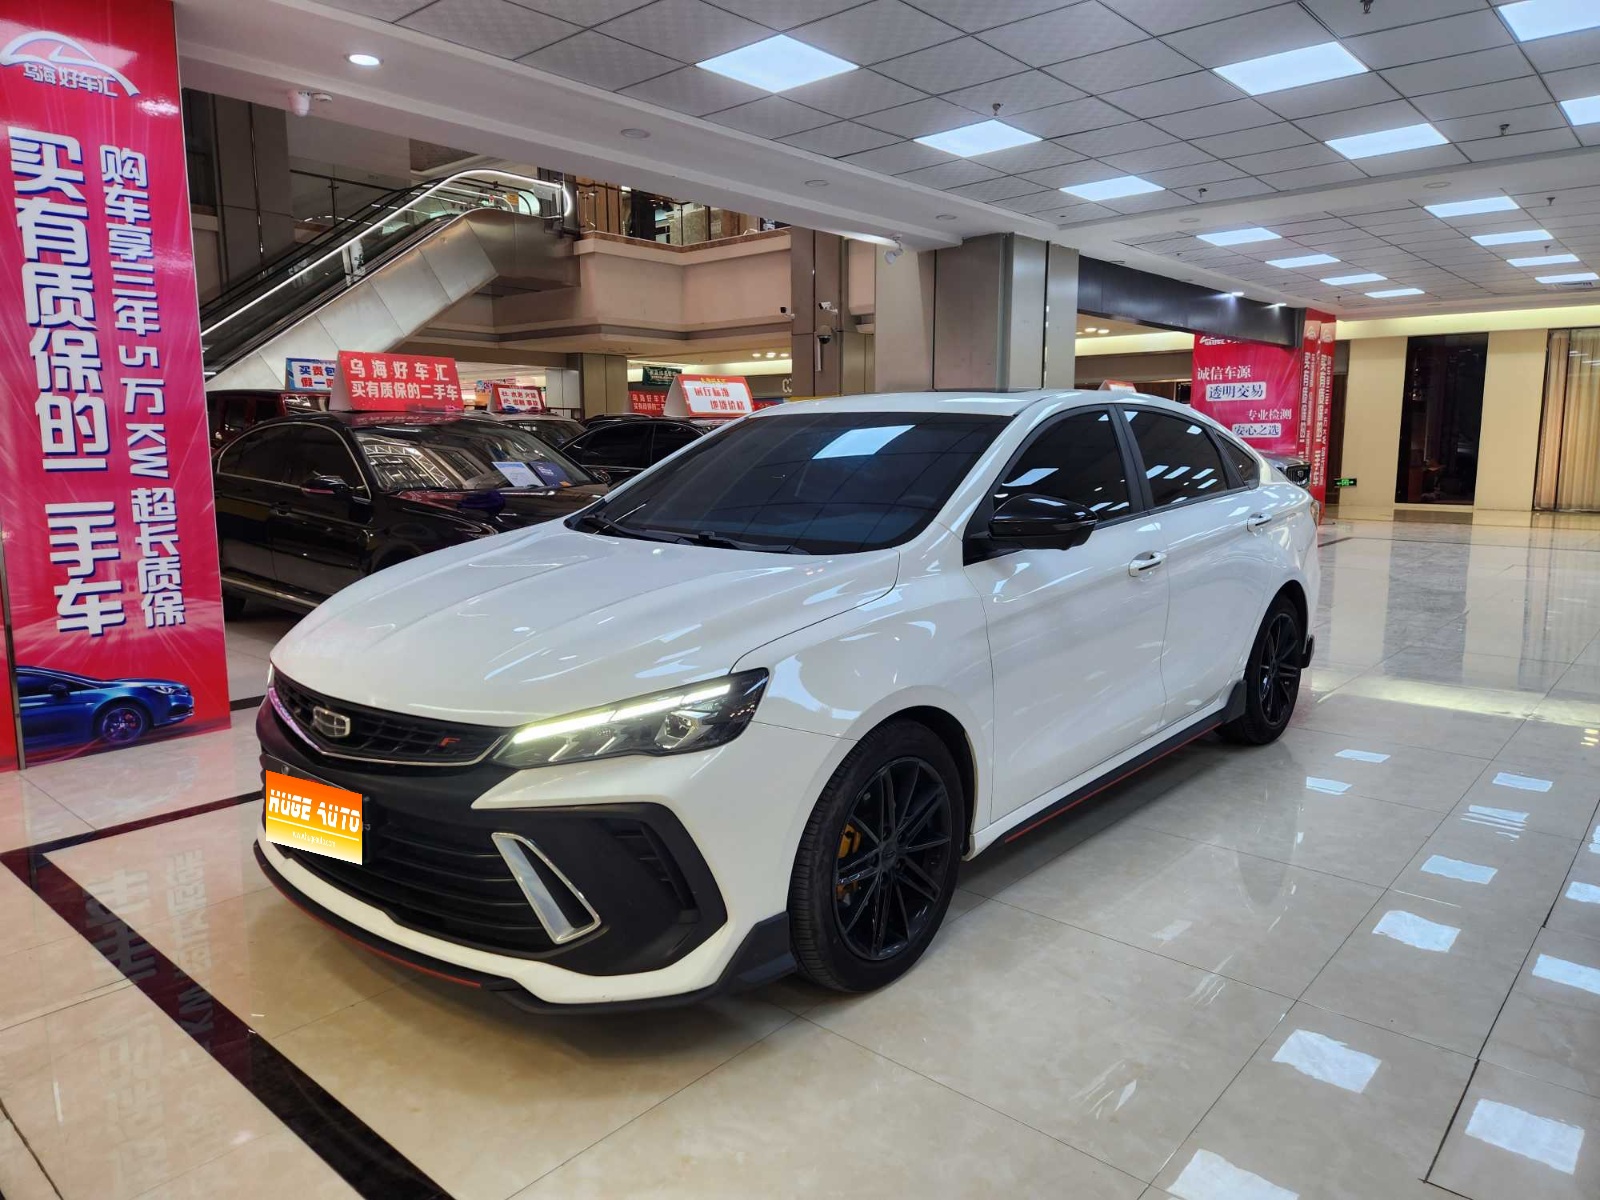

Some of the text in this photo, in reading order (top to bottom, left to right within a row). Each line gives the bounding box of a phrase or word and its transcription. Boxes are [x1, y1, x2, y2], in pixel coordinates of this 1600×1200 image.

[23, 63, 118, 97] 乌海好车汇
[350, 359, 449, 381] 乌海好车汇
[1197, 365, 1252, 381] 诚信车源
[8, 126, 126, 635] 买有质保的二手车
[351, 380, 459, 400] 买有质保的二手车
[1208, 384, 1264, 400] 透明交易
[1248, 408, 1292, 421] 专业检测
[1234, 424, 1280, 436] 安心之选
